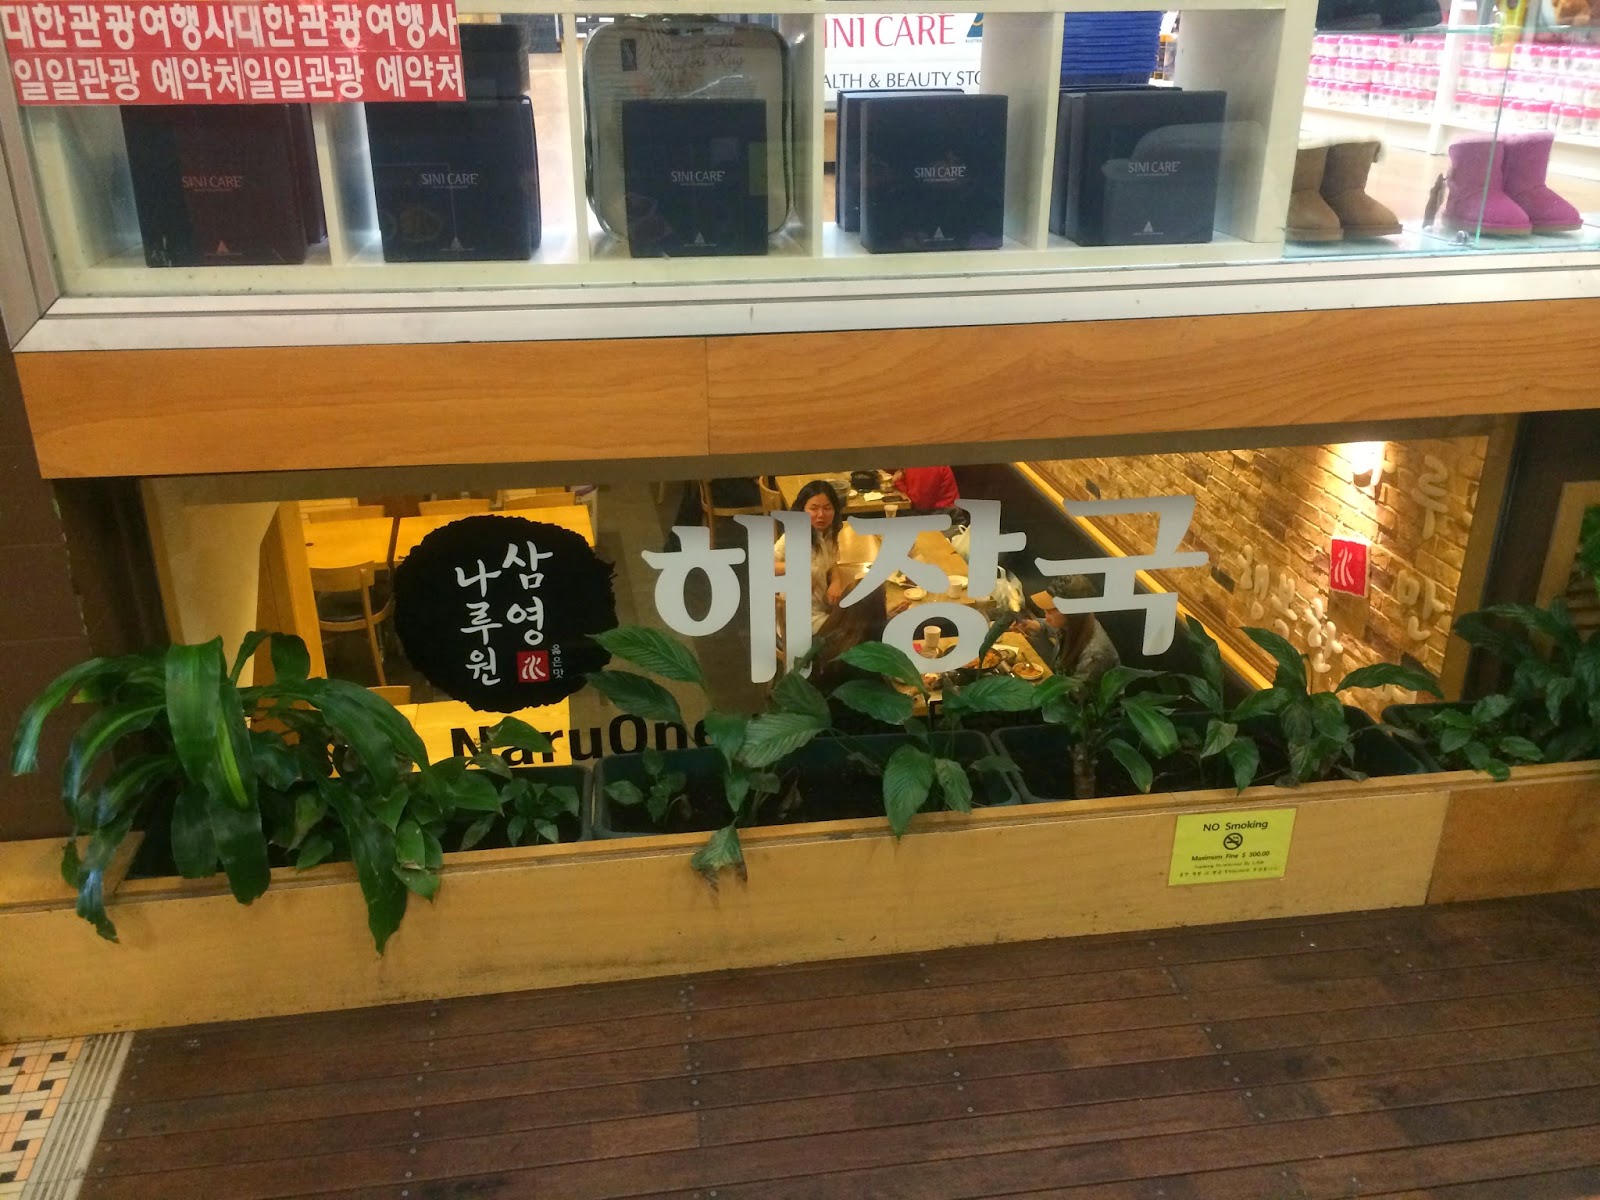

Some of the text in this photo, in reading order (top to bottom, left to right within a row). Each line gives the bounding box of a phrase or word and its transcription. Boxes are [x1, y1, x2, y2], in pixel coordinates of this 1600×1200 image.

[0, 3, 234, 50] 대한관광여행사
[232, 3, 456, 49] 대한관광여행사
[875, 15, 955, 47] CARE
[14, 56, 244, 100] 일일관광 예약처
[244, 54, 464, 99] 일일관광 예약처
[869, 73, 881, 88] &
[887, 72, 951, 88] BEAUTY
[181, 176, 242, 188] SINI CARE
[421, 173, 478, 185] SINI CARE
[671, 170, 724, 182] SINI CARE
[914, 166, 966, 178] SINI CARE
[1128, 161, 1179, 174] SINI CARE
[502, 541, 553, 646] 삼영
[642, 495, 1209, 683] 해장국
[455, 559, 502, 686] 나루원
[1203, 820, 1268, 832] NO Smoking
